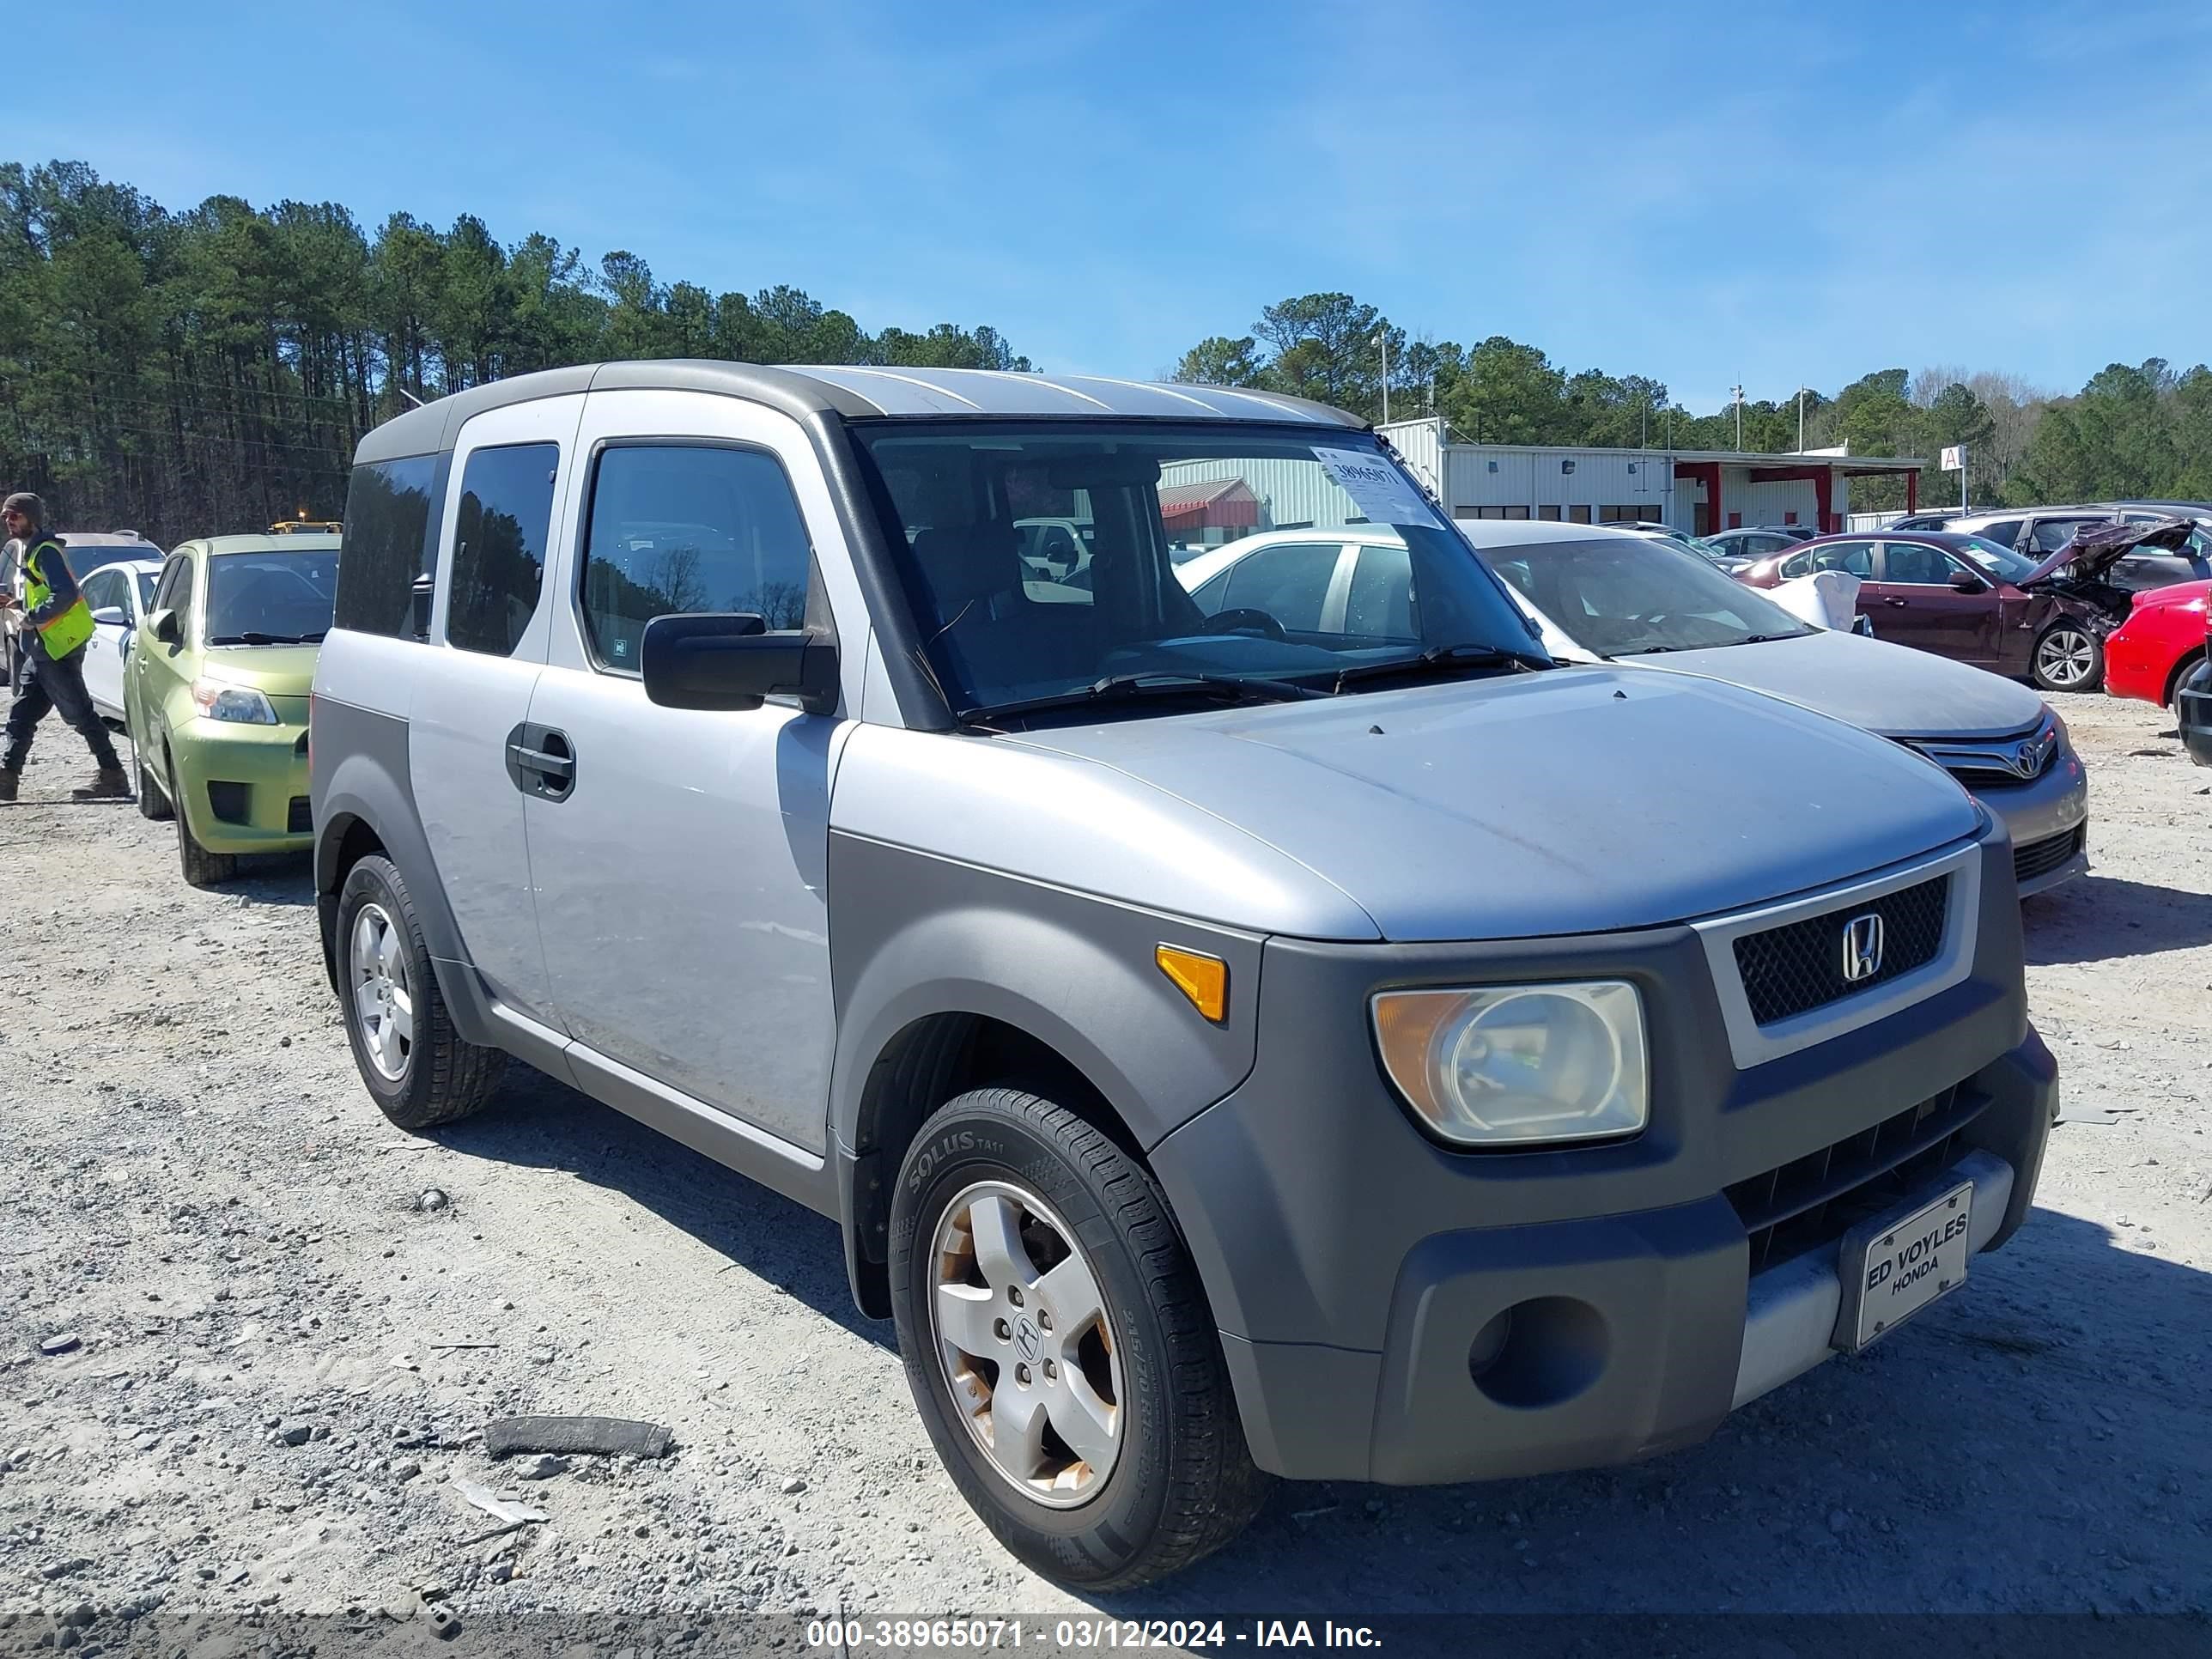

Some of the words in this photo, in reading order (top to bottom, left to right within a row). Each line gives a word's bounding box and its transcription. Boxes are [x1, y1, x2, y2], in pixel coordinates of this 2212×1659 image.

[1334, 464, 1399, 484] 38965071
[1945, 449, 1957, 468] A
[909, 1131, 975, 1194] SOLUS
[1867, 1259, 1892, 1291] ED
[1898, 1212, 1966, 1270] VOYLES
[1892, 1255, 1938, 1296] HONDA
